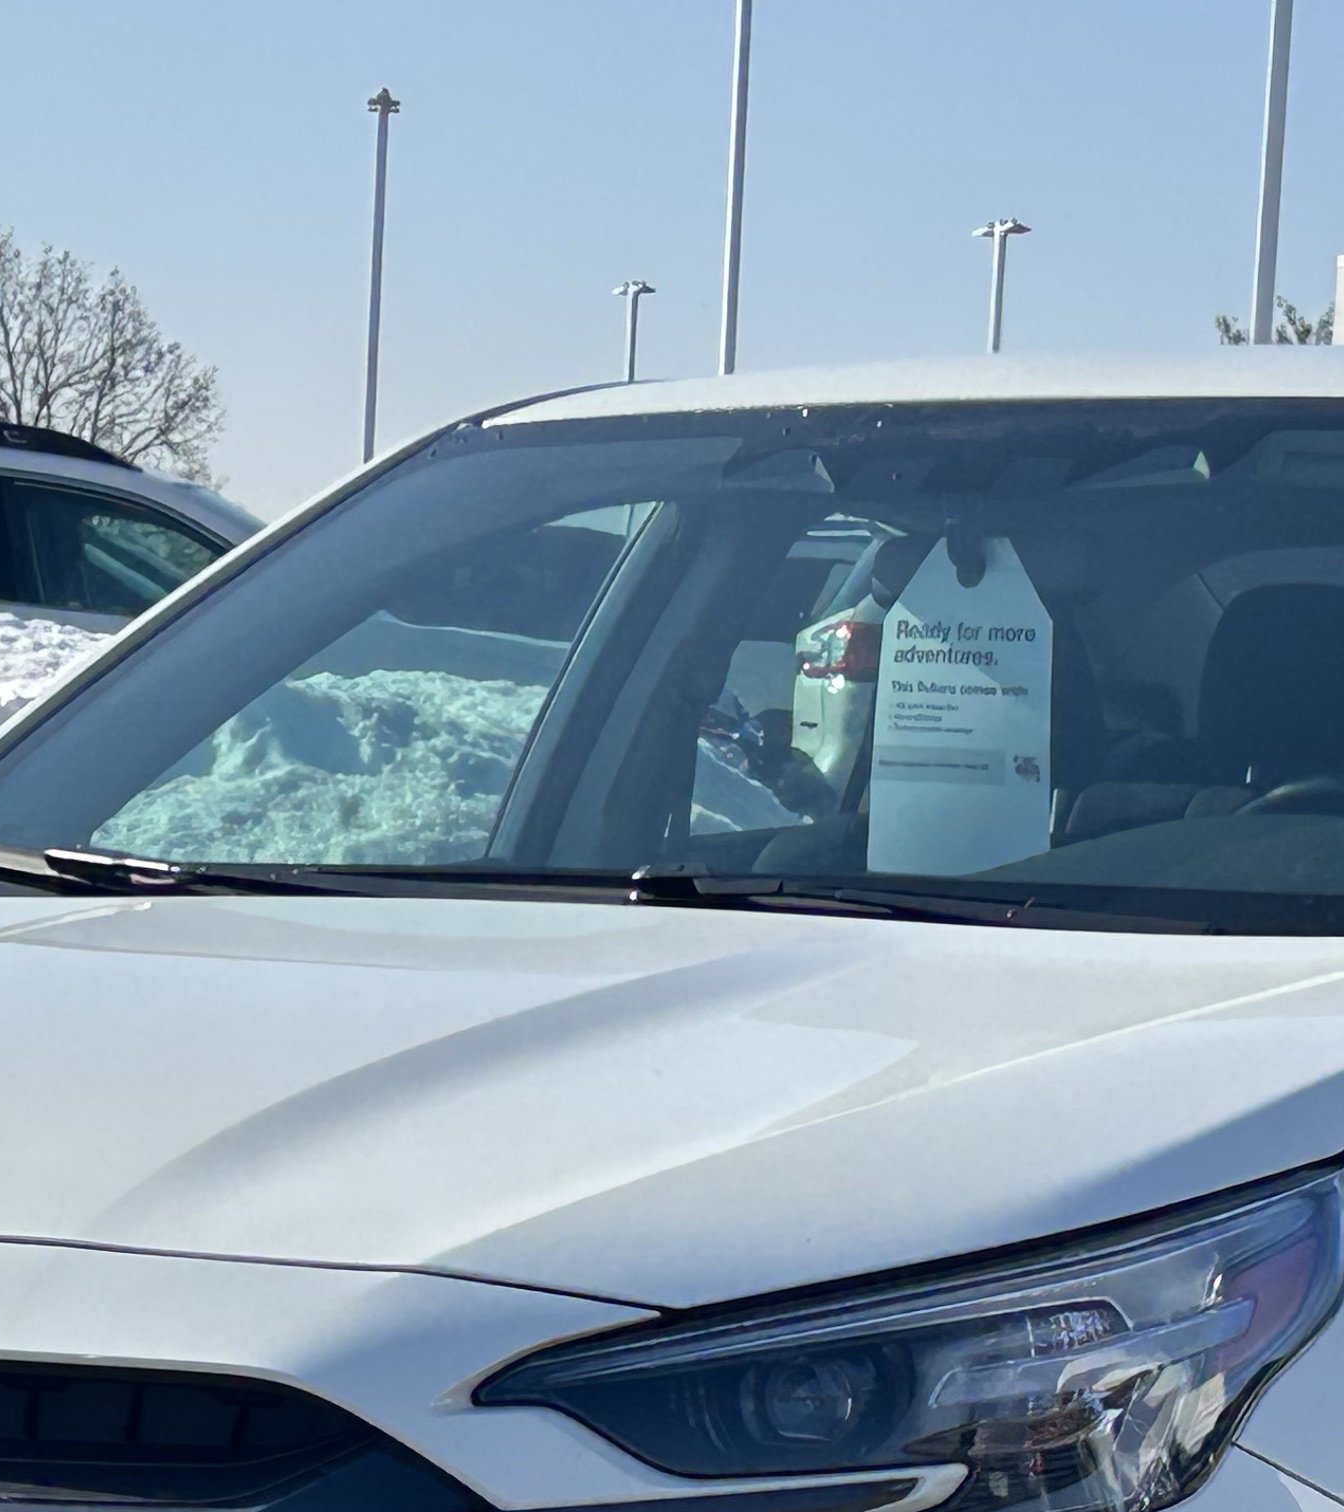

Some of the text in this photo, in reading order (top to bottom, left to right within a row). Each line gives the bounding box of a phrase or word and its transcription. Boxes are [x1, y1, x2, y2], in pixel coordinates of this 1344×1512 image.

[896, 620, 1036, 643] Ready for more
